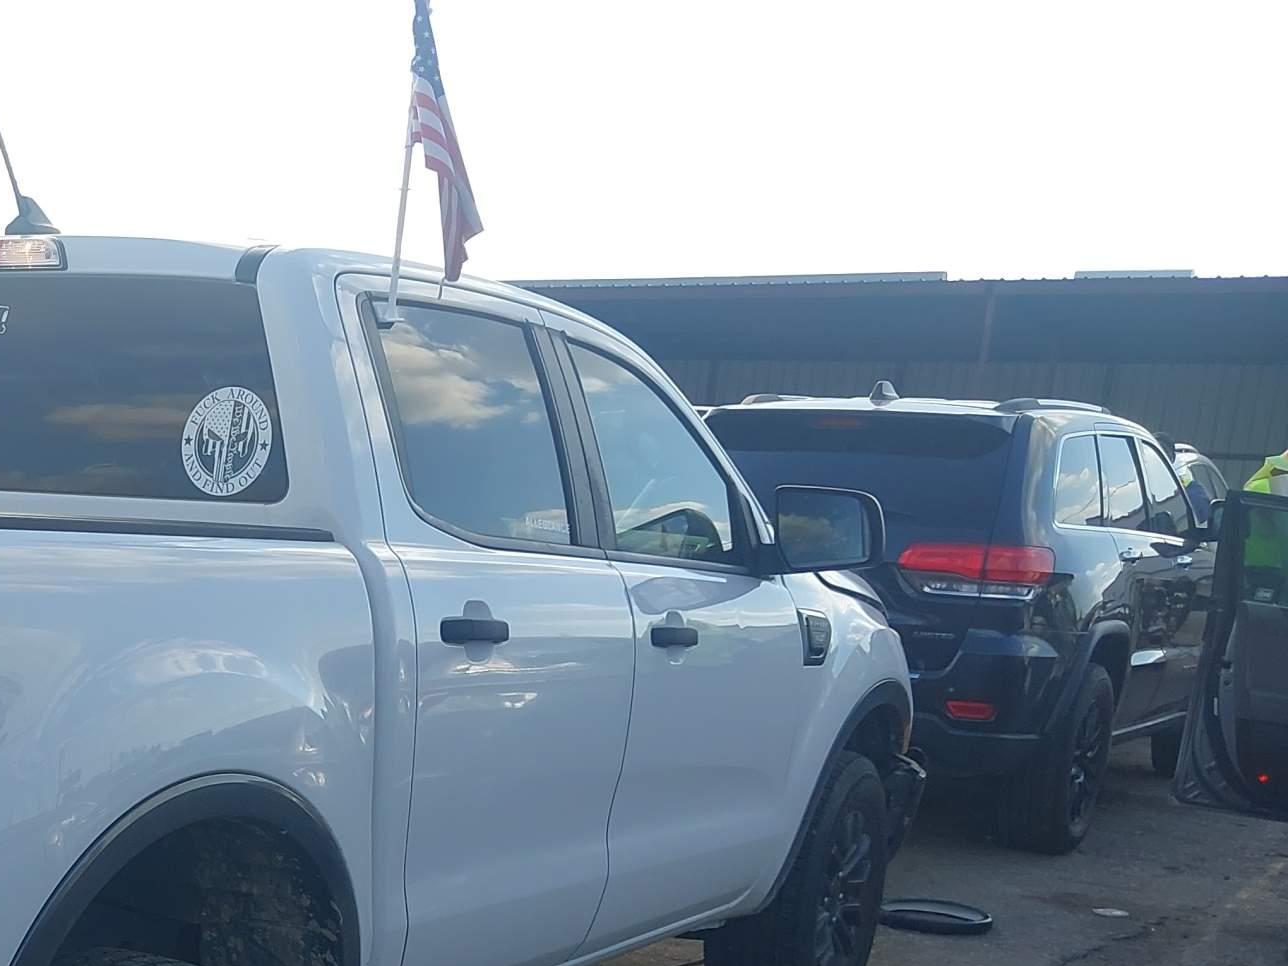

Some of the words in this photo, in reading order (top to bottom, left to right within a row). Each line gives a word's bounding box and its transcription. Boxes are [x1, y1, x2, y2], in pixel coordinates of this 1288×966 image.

[191, 392, 221, 426] FUCK
[227, 388, 269, 431] AROUND
[184, 453, 202, 482] AND
[202, 479, 235, 494] FIND
[238, 458, 263, 487] OUT
